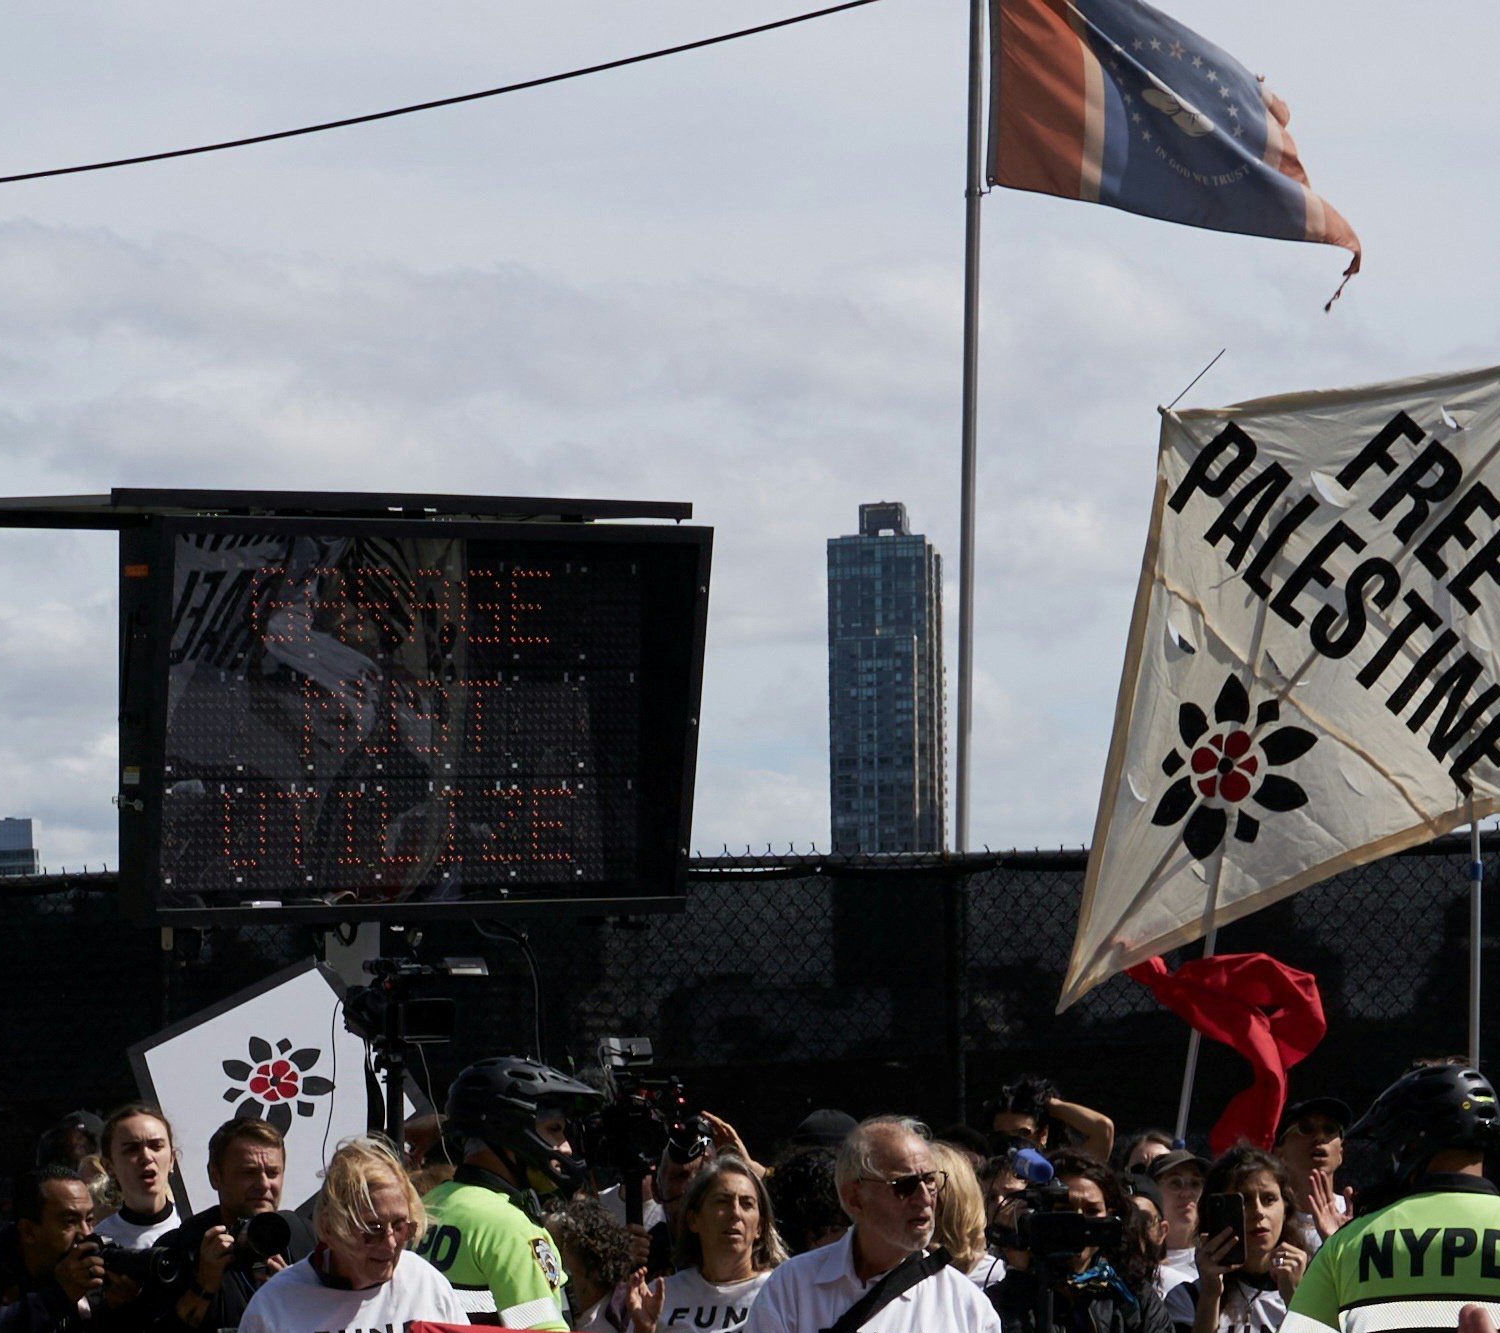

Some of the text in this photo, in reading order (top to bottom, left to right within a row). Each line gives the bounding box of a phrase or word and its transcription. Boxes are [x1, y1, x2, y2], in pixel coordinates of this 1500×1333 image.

[252, 567, 550, 644] GARAGE
[305, 679, 500, 755] MUST
[223, 787, 572, 866] UTILIZE
[667, 1308, 750, 1328] FUN
